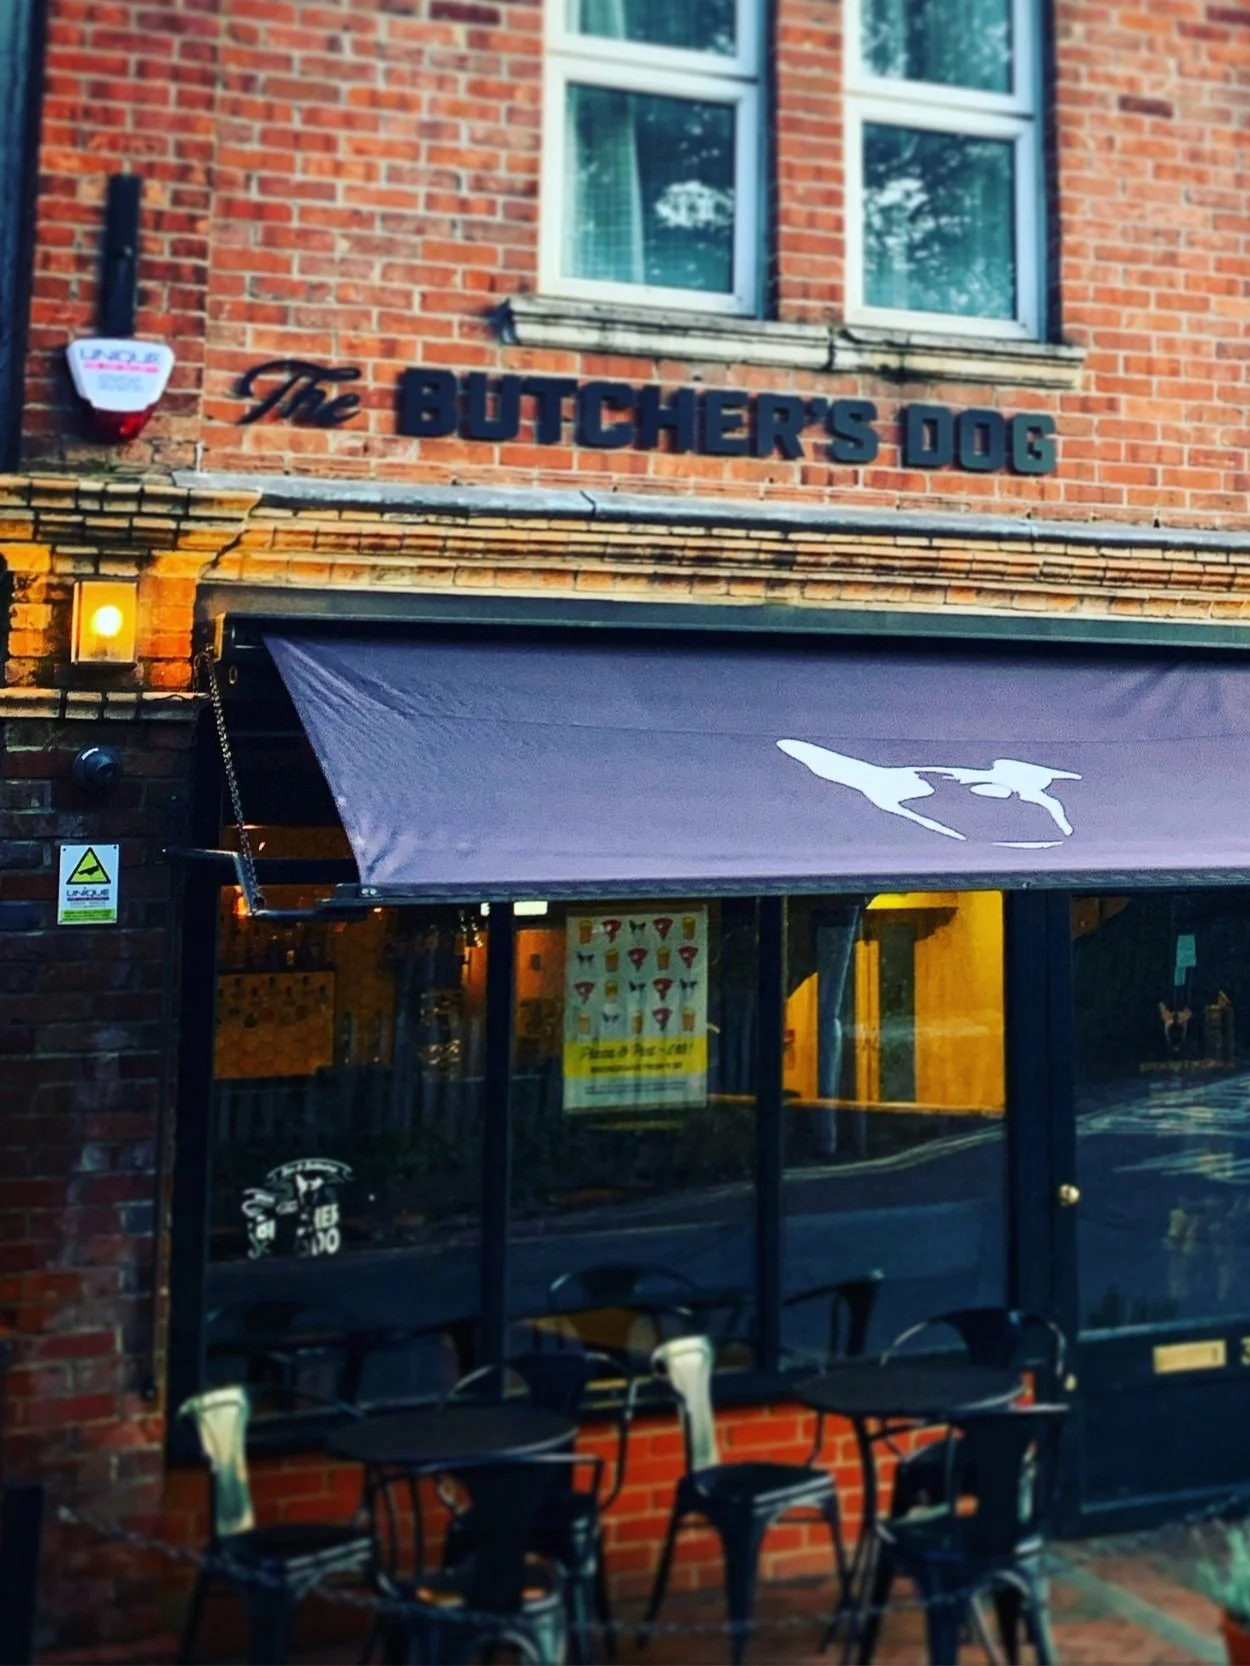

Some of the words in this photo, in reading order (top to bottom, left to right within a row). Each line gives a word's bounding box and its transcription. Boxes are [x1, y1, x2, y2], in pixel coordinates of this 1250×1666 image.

[233, 358, 361, 427] The
[398, 366, 879, 463] BUTCHER'S
[898, 402, 1056, 477] DOG
[66, 886, 109, 898] UNIQUE
